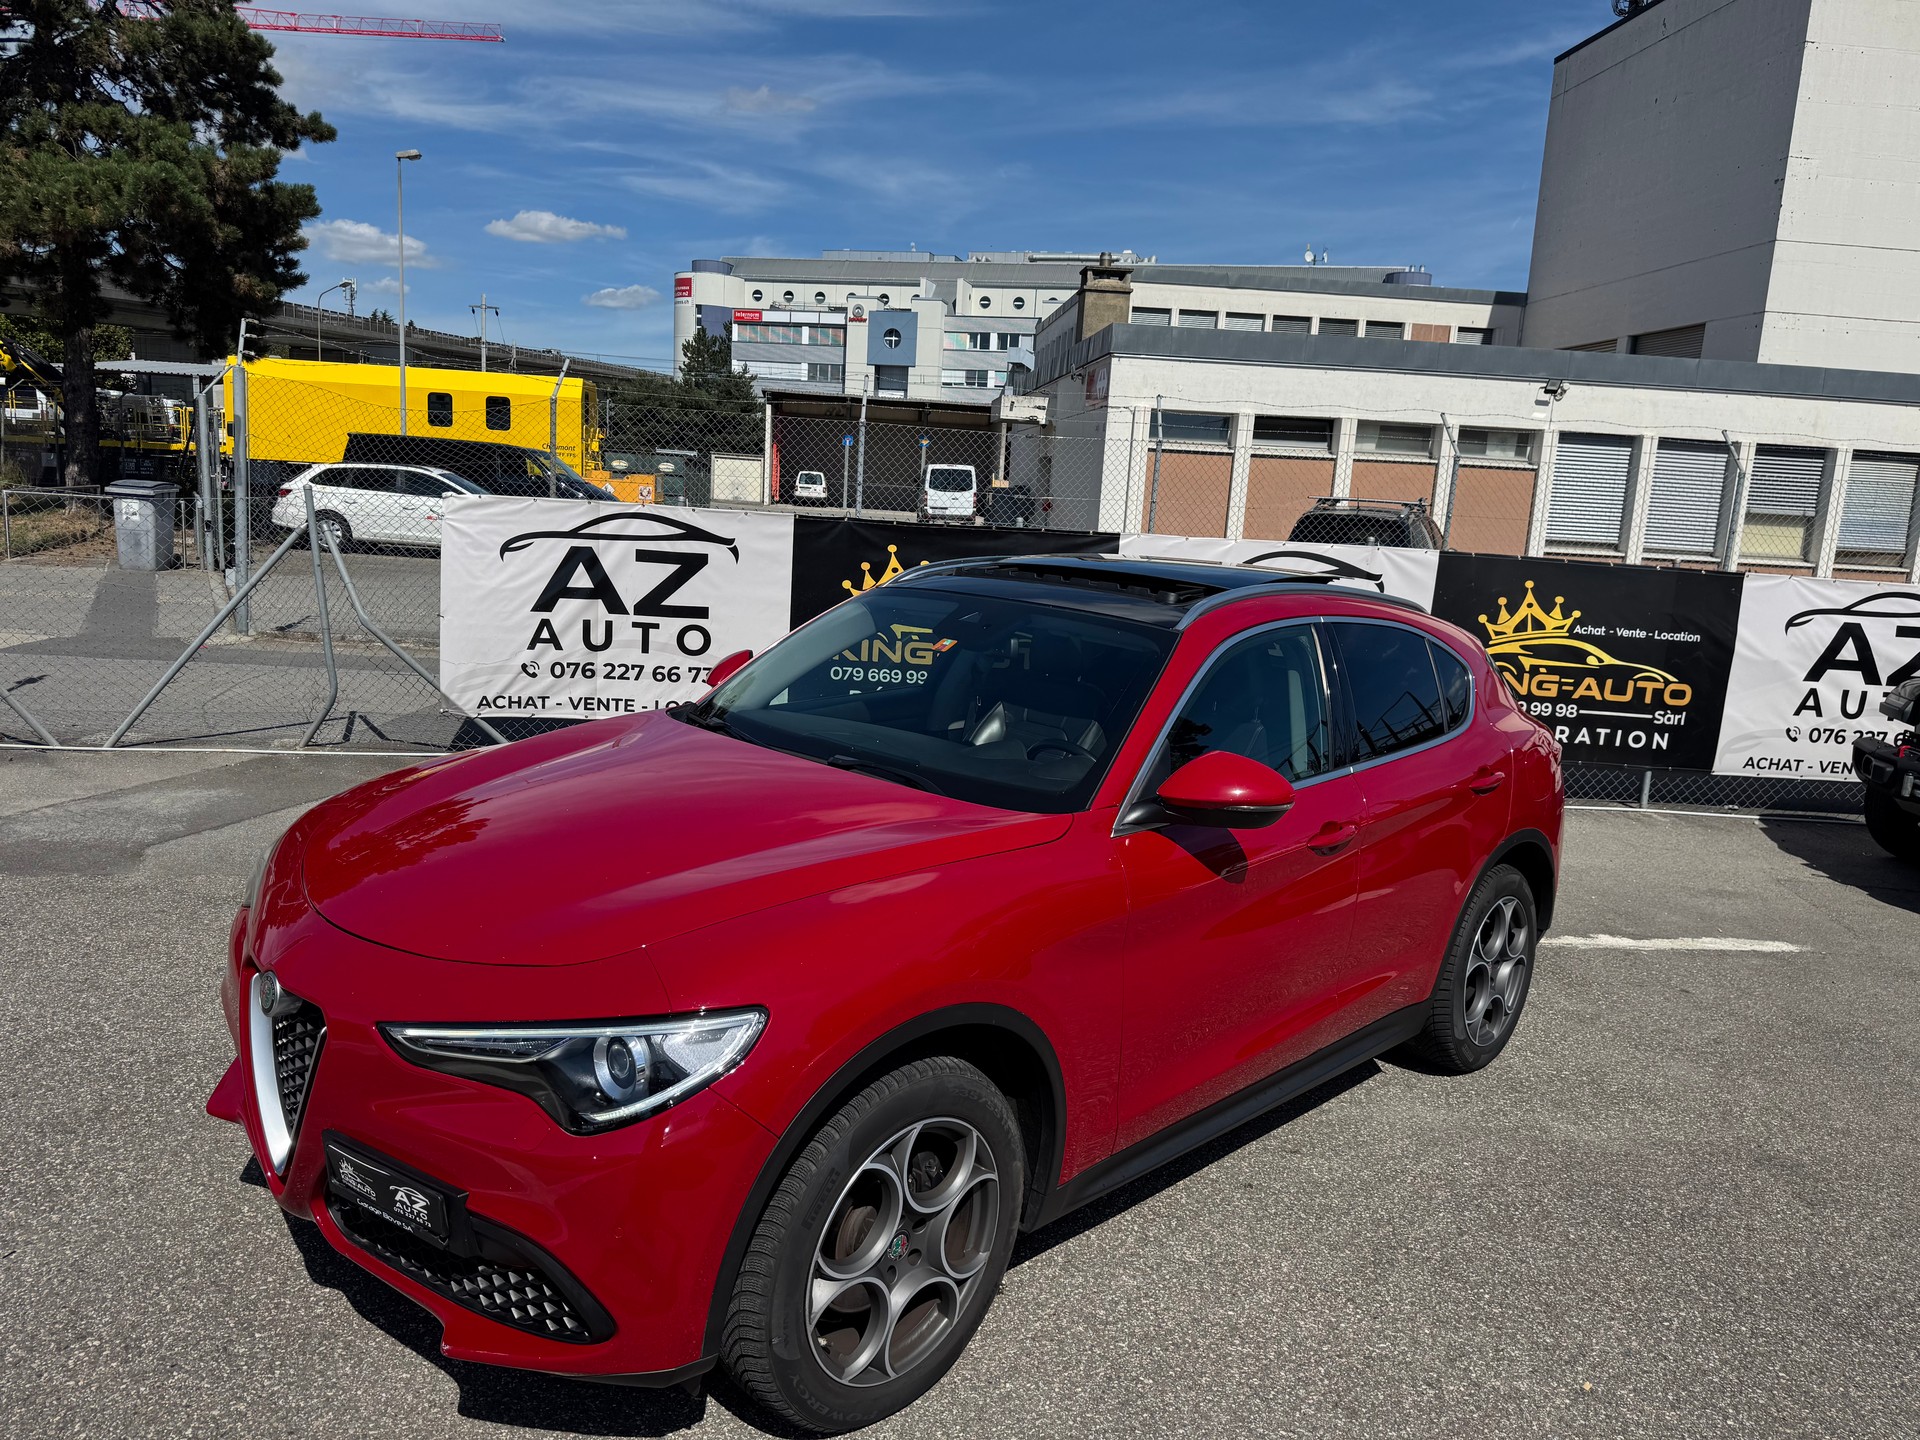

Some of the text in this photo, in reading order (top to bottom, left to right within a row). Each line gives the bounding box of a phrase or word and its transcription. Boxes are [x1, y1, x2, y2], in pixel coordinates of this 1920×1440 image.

[542, 443, 576, 451] Chumont
[530, 546, 709, 619] AZ
[527, 618, 712, 656] AUTO
[1573, 625, 1606, 636] Achat
[1615, 627, 1646, 638] Vente
[1654, 630, 1701, 643] Location
[550, 662, 596, 679] 076
[603, 663, 645, 681] 227
[652, 666, 681, 683] 66
[830, 666, 864, 681] 079
[867, 668, 902, 683] 669
[1502, 671, 1693, 706] NG-AUTO
[477, 695, 550, 710] ACHAT
[568, 696, 636, 712] VENTE
[1530, 702, 1552, 716] 99
[1555, 703, 1578, 718] 98
[1653, 710, 1686, 726] Sàrl
[1555, 725, 1669, 750] RATION
[1808, 727, 1846, 745] 076
[1743, 756, 1804, 772] ACHAT
[1819, 760, 1854, 775] VEN
[394, 1190, 428, 1214] AZ
[395, 1201, 428, 1220] AUTO
